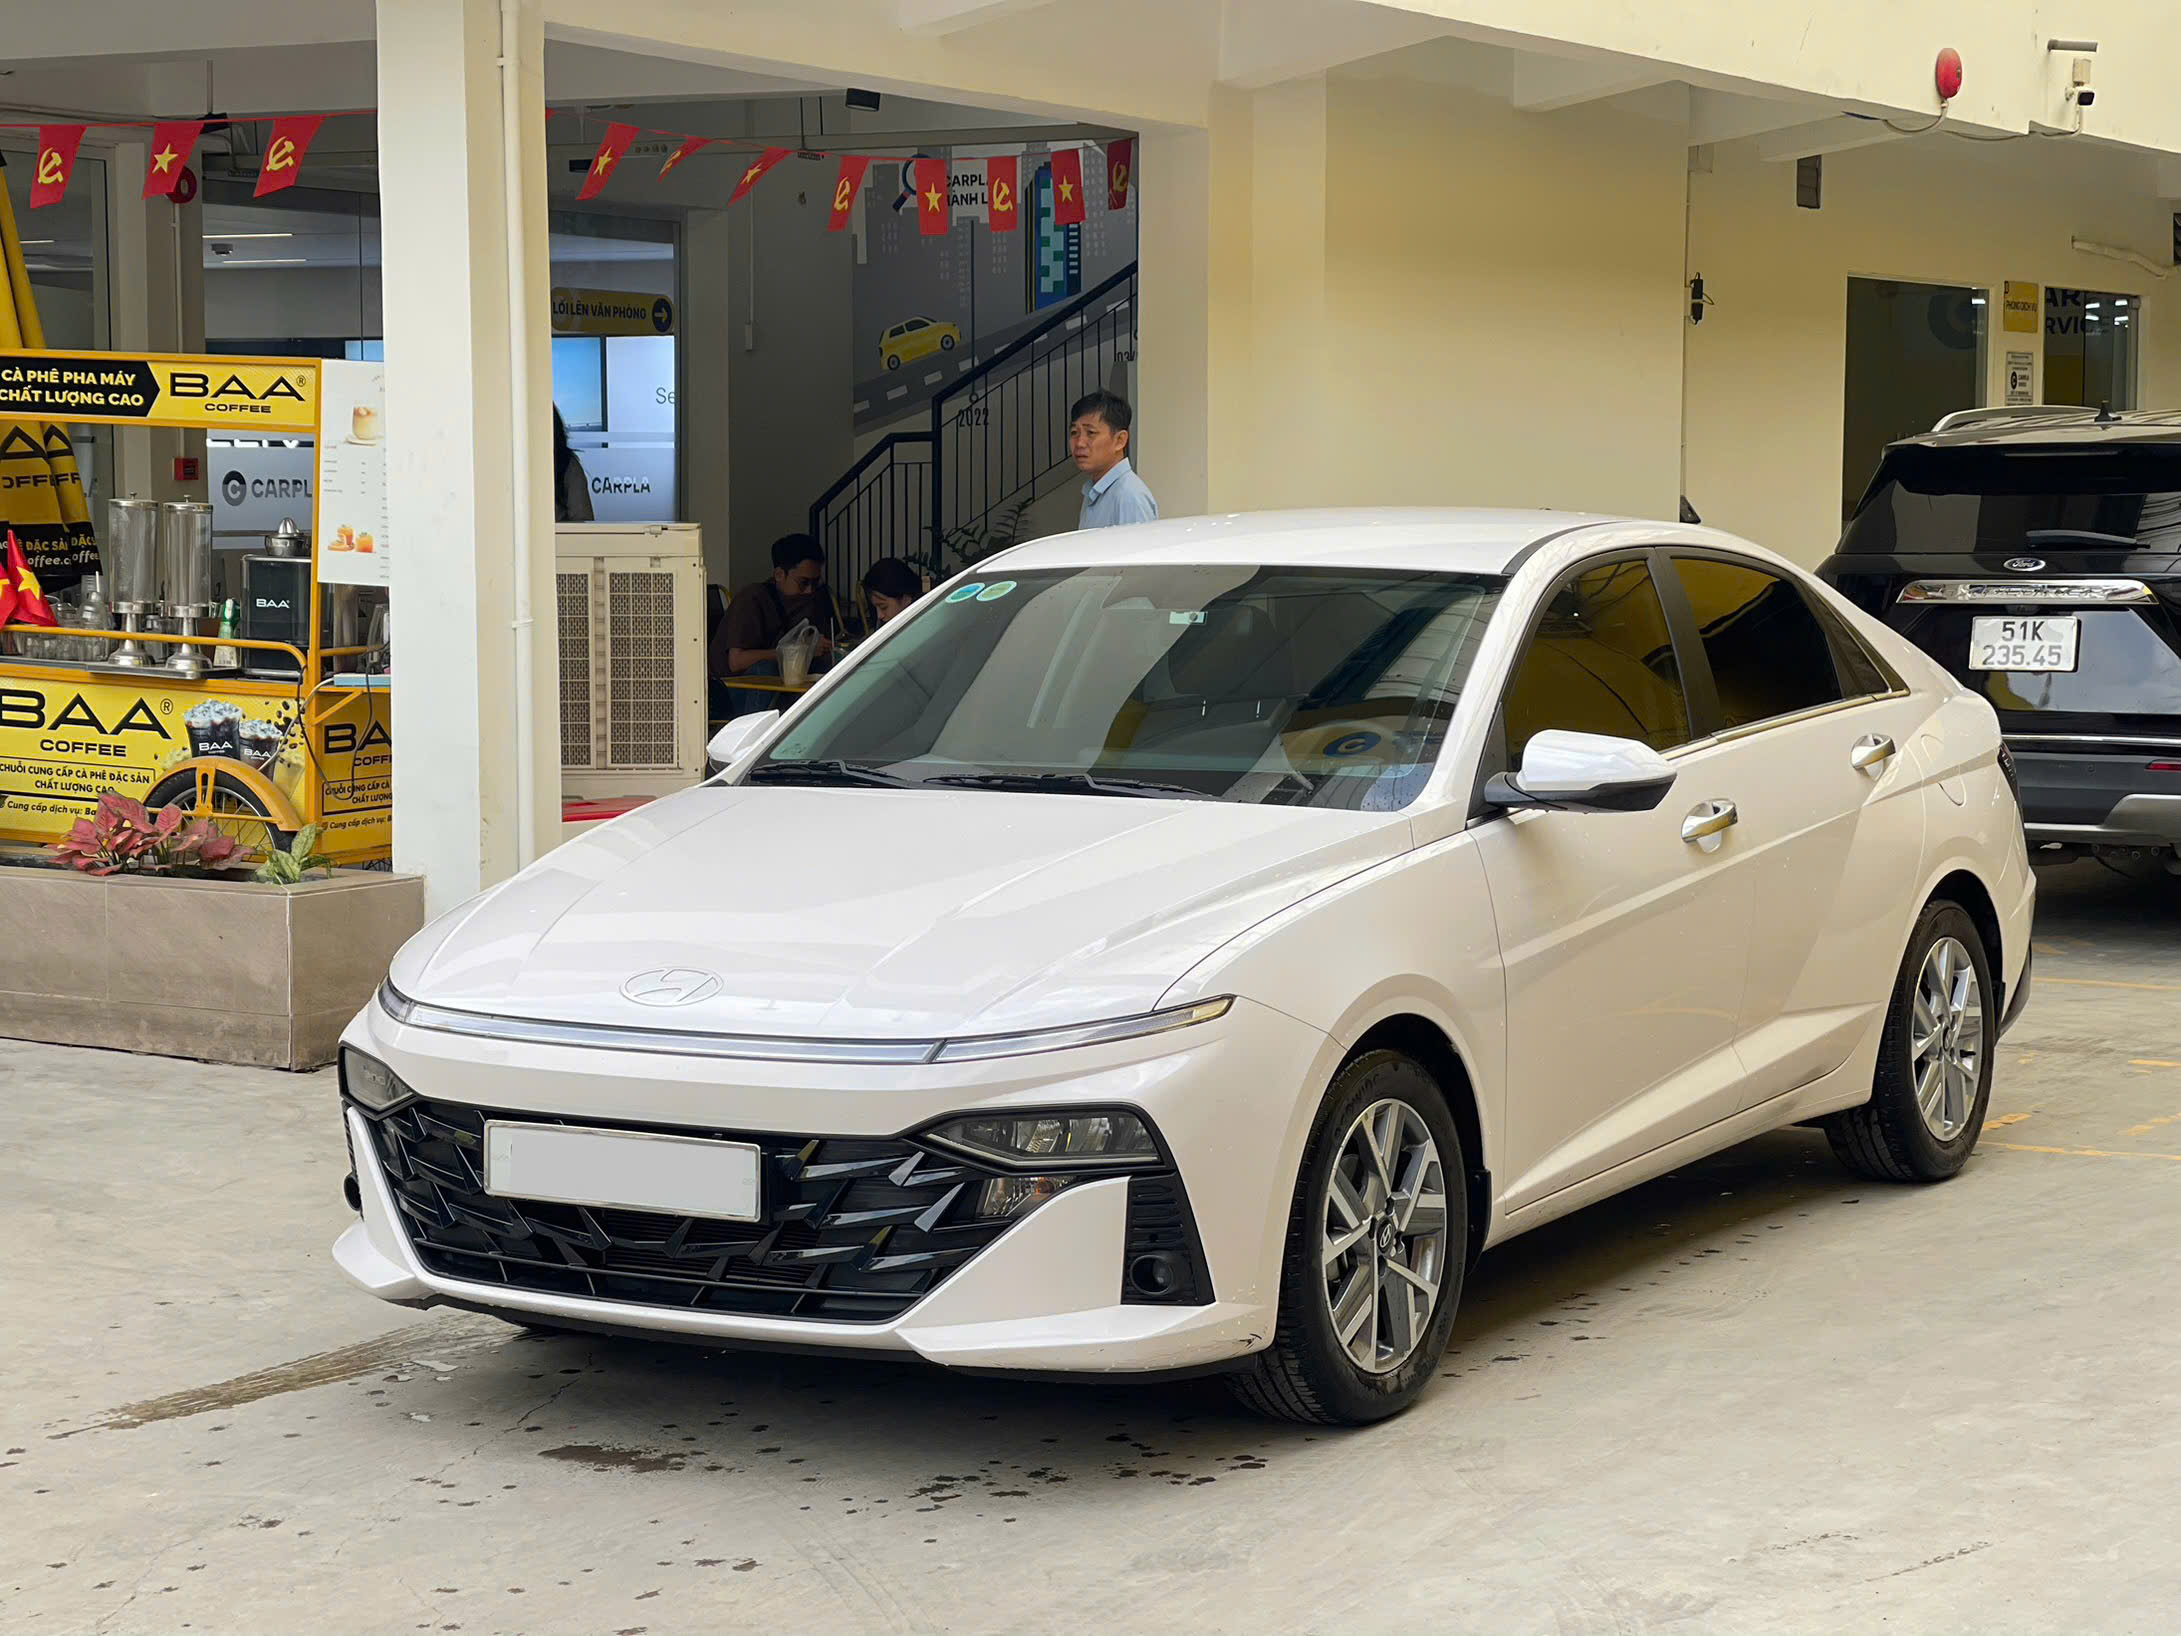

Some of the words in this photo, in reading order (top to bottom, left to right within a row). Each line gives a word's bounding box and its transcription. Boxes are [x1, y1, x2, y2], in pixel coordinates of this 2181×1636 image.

[947, 174, 989, 187] ARPL
[1, 366, 24, 382] CÀ
[26, 368, 60, 384] PHÊ
[62, 371, 98, 385] PHA
[100, 370, 136, 386] MÁY
[0, 385, 42, 402] CHẤT
[45, 389, 105, 407] LƯỢNG
[108, 393, 144, 406] CAO
[204, 403, 272, 414] COFFEE
[591, 476, 651, 494] CARPLA
[2002, 620, 2045, 641] 51K
[1982, 645, 2062, 667] 235.45
[40, 739, 126, 757] COFFEE
[199, 741, 233, 751] BAA
[244, 748, 272, 758] BAA
[354, 755, 392, 767] COFF
[28, 765, 53, 776] CUNG
[55, 766, 73, 778] CẤP
[75, 768, 88, 779] CÀ
[89, 770, 107, 781] PHÊ
[109, 771, 128, 784] ĐẶC
[130, 772, 150, 784] SẢN
[35, 778, 59, 790] CHẤT
[60, 781, 94, 794] LƯỢNG
[7, 800, 30, 811] Cung
[31, 803, 48, 813] cấp
[49, 804, 68, 815] dịch
